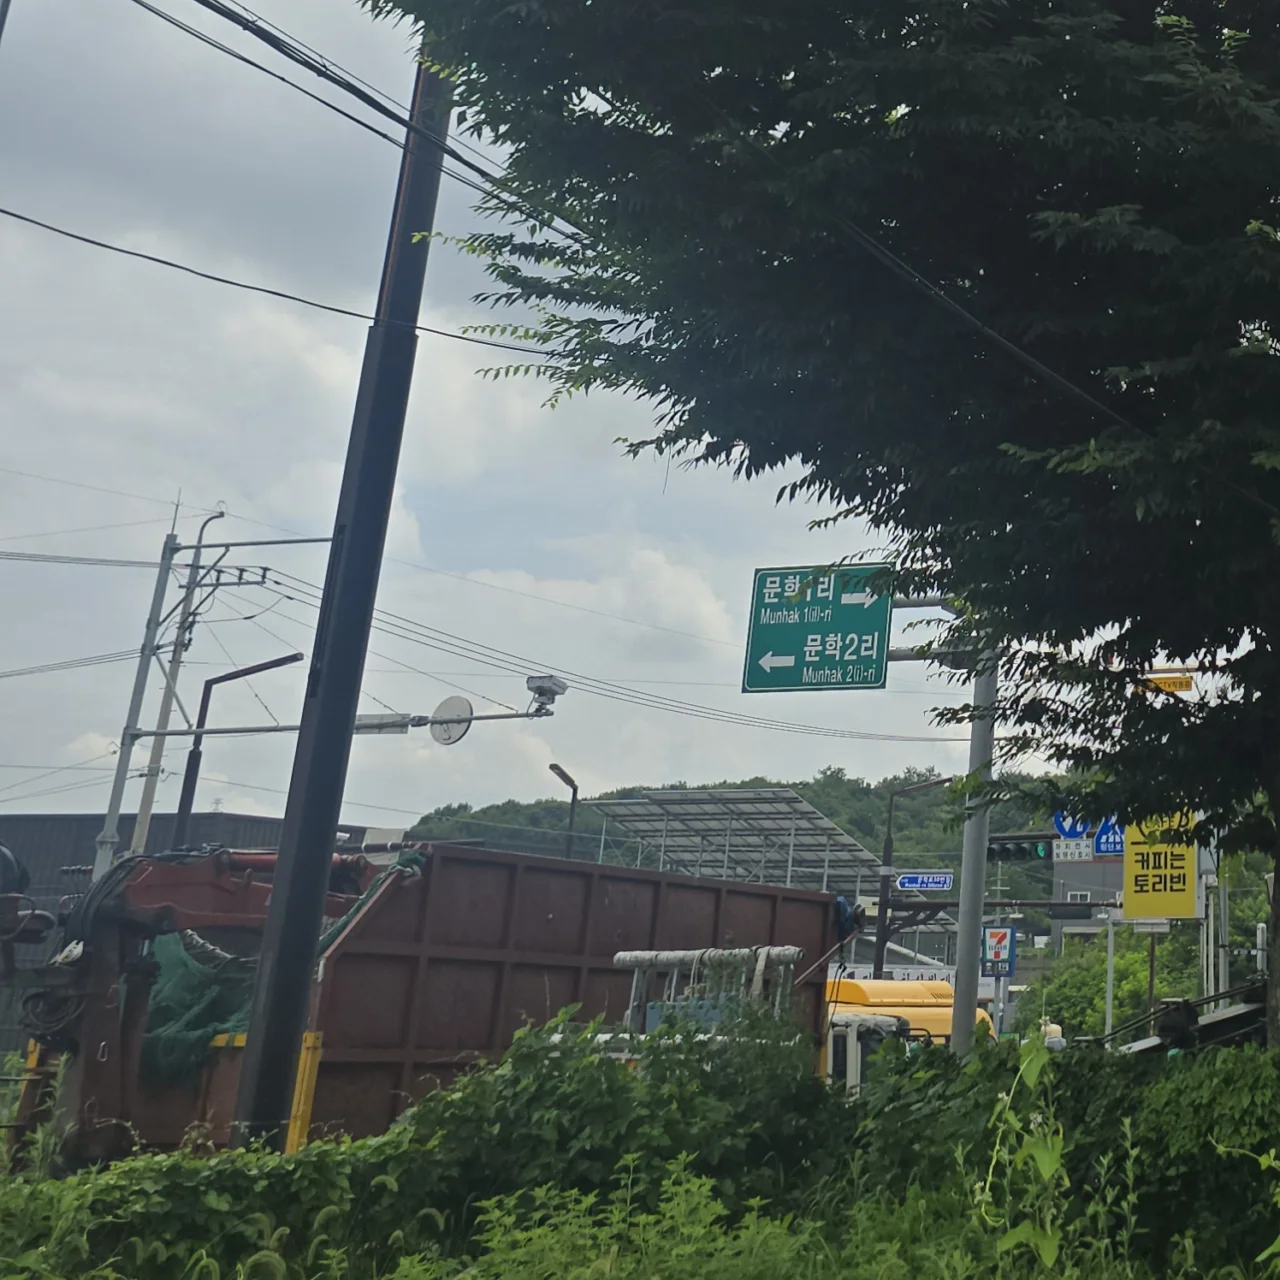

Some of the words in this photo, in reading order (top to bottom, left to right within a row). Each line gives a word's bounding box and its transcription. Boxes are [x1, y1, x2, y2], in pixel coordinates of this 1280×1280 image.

[760, 607, 800, 625] Munhak
[803, 632, 879, 662] 문학2리
[802, 666, 843, 684] Munhak
[846, 665, 876, 683] 2(i)-ri
[1101, 842, 1124, 852] 횡단보
[1134, 851, 1186, 871] 커피는
[1134, 873, 1187, 894] 토리빈
